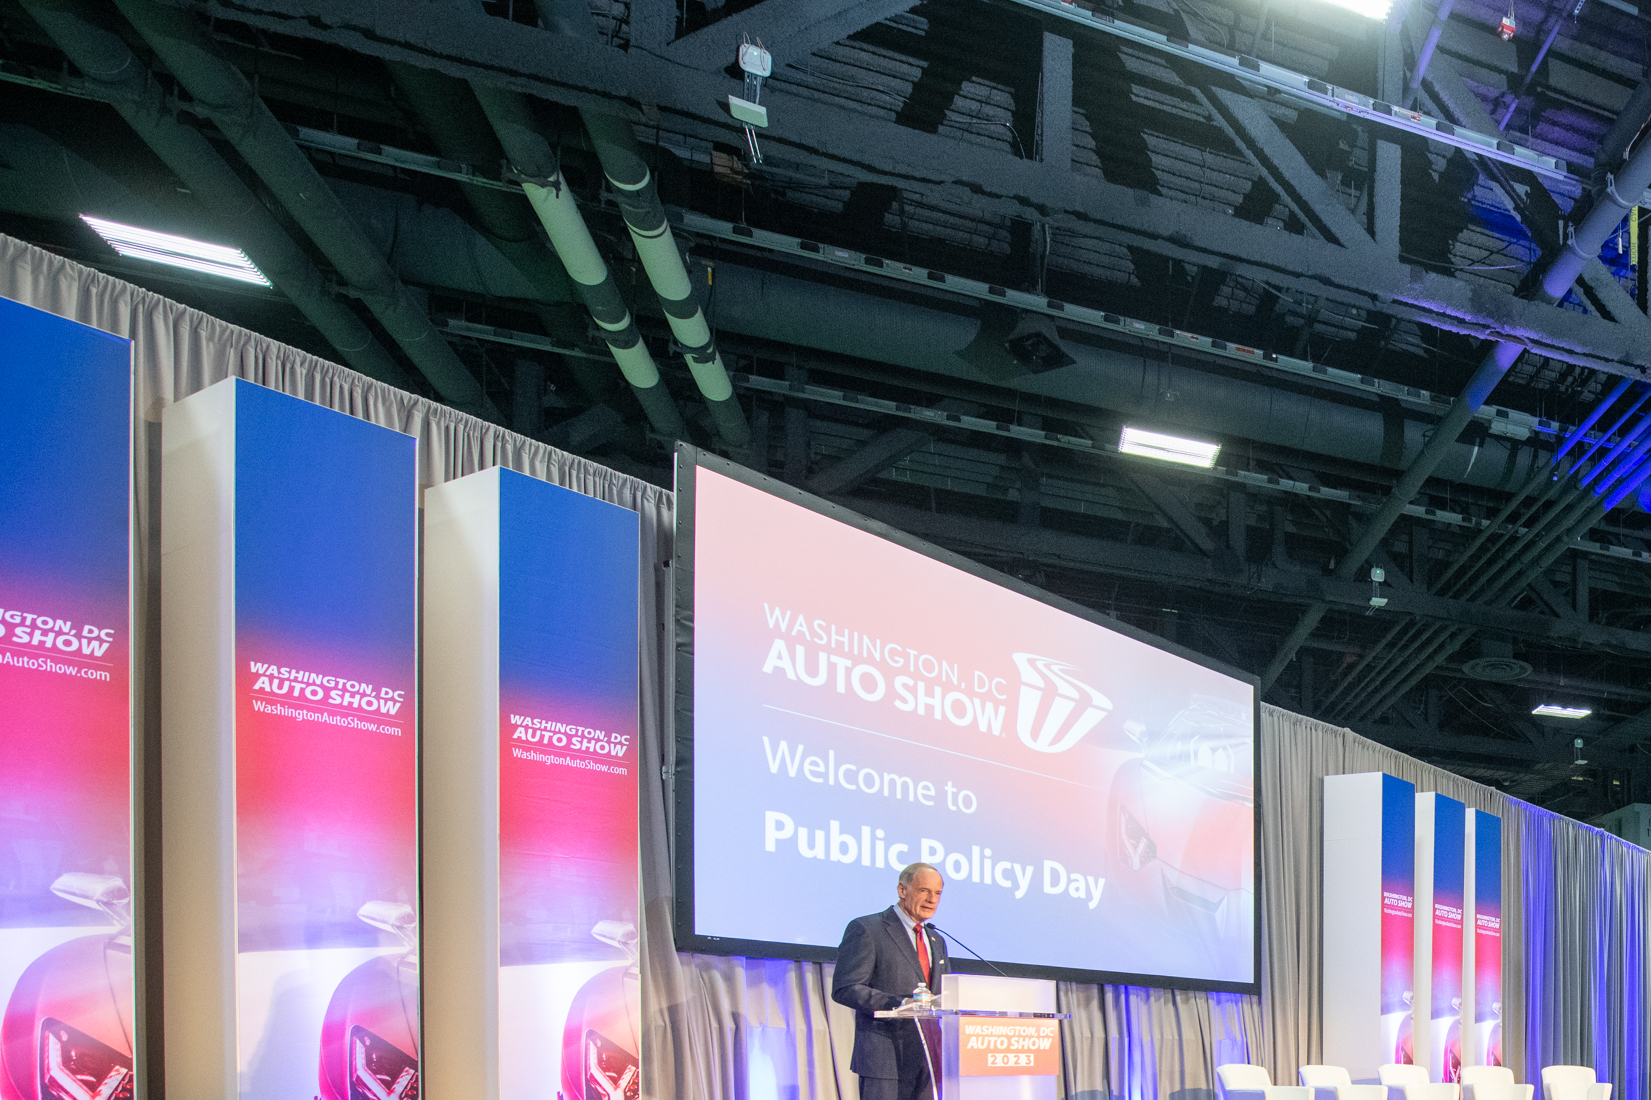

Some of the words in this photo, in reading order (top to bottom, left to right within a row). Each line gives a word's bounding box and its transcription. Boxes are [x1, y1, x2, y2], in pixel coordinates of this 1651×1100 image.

[12, 626, 110, 657] SHOW
[82, 625, 115, 641] DC
[763, 602, 965, 689] WASHINGTON,
[974, 670, 1007, 700] DC
[250, 661, 376, 697] WASHINGTON,
[380, 687, 405, 701] DC
[762, 637, 886, 702] AUTO
[253, 676, 324, 700] AUTO
[328, 690, 401, 715] SHOW
[253, 700, 402, 736] WashingtonAutoShow.com
[510, 714, 607, 741] WASHINGTON,
[611, 733, 630, 745] DC
[512, 727, 567, 746] AUTO
[570, 737, 627, 757] SHOW
[512, 747, 628, 775] WashingtonAutoShow.com
[763, 736, 936, 806] Welcome
[944, 781, 977, 814] to
[765, 810, 909, 872] Public
[920, 838, 1034, 900] Policy
[1043, 860, 1106, 910] Day
[1384, 898, 1397, 906] AUTO
[1398, 900, 1412, 909] SHOW
[1435, 909, 1447, 917] AUTO
[1448, 911, 1462, 920] SHOW
[965, 1025, 1038, 1037] WASHINGTON,
[1040, 1027, 1054, 1036] DC
[966, 1036, 1008, 1049] AUTO
[1010, 1037, 1052, 1050] SHOW
[989, 1054, 1032, 1066] 2023
